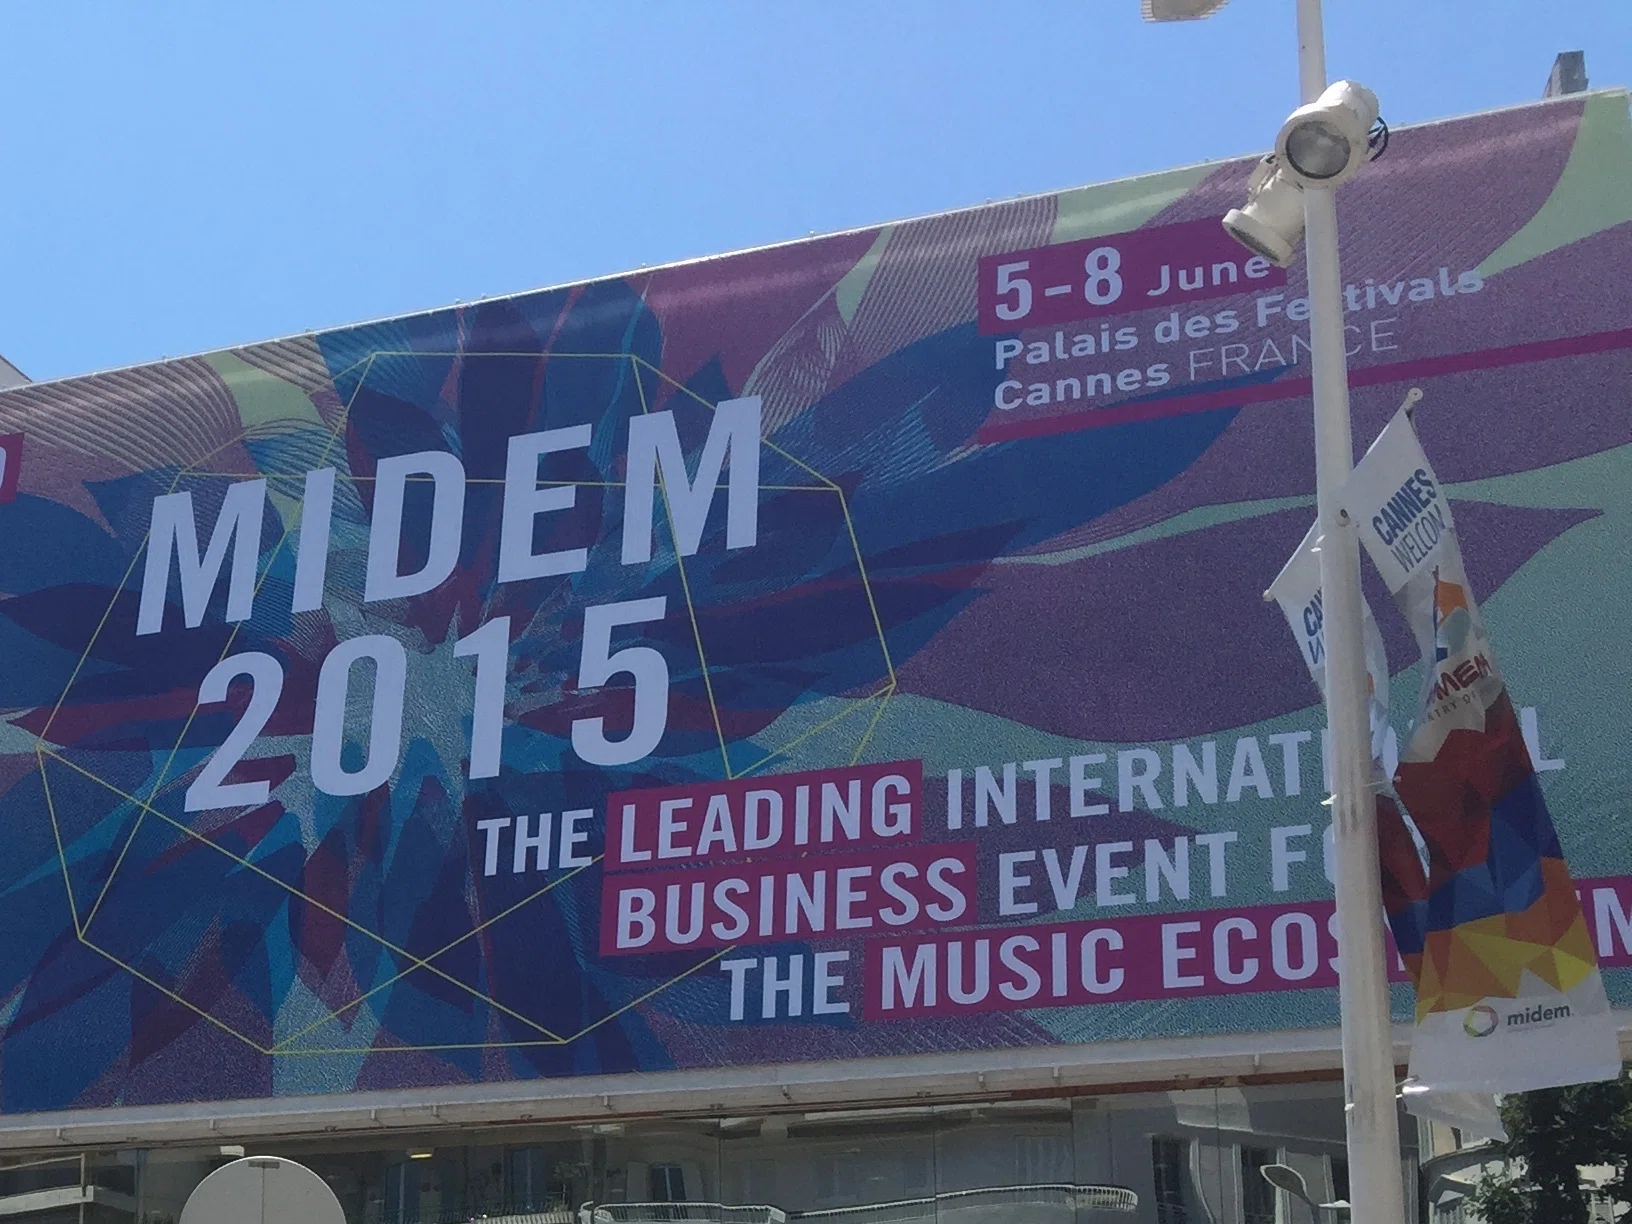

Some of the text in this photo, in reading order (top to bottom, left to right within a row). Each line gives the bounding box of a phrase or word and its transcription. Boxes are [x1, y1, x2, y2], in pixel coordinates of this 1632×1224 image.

[994, 266, 1485, 370] Palais des Fetivals
[1147, 255, 1271, 297] June
[994, 363, 1171, 411] Cannes
[135, 394, 763, 637] MIDEM
[1372, 469, 1437, 546] CANNES
[183, 595, 670, 814] 2015
[476, 808, 595, 877] THE
[618, 774, 913, 864] LEADING
[614, 857, 968, 950] BUSINESS
[997, 831, 1239, 917] EVENT
[720, 950, 851, 1022] THE
[880, 928, 1125, 1012] MUSIC
[1507, 1004, 1571, 1026] midem
